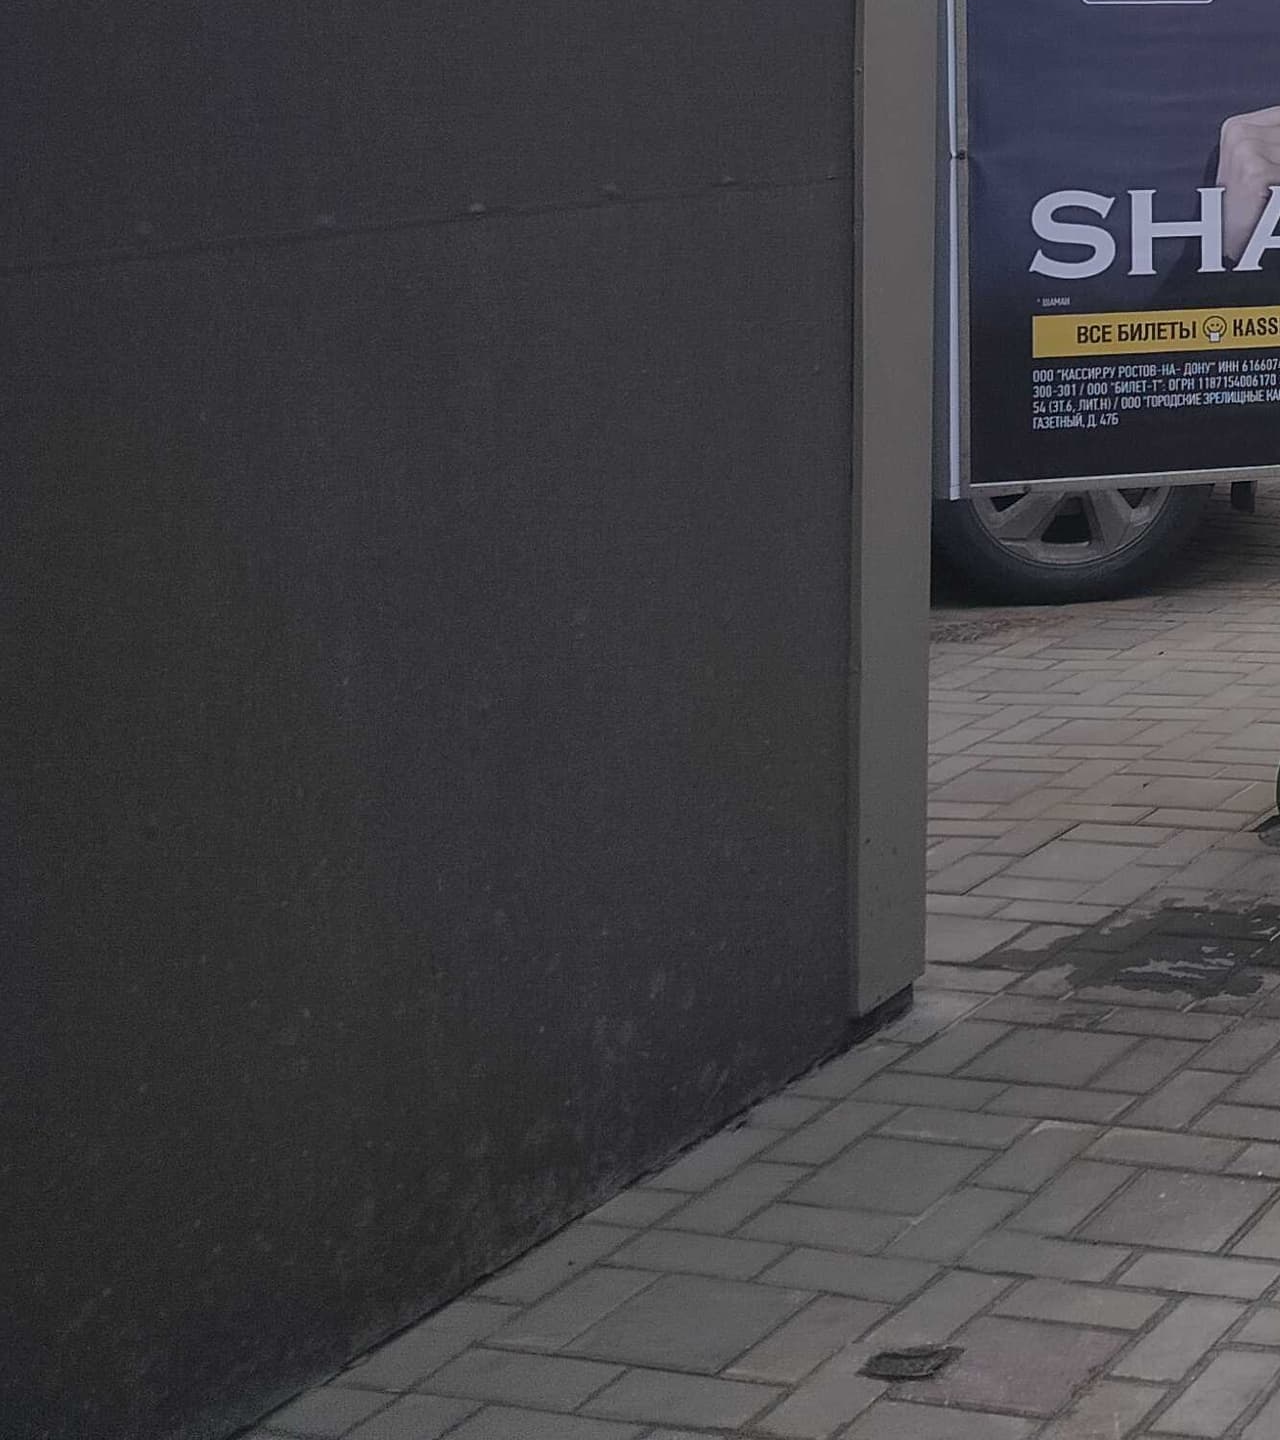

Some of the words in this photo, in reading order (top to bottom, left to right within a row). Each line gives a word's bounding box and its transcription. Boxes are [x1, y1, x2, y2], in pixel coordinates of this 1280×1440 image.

[1076, 325, 1112, 344] ВСЕ
[1117, 321, 1197, 342] БИЛЕТЫ
[1033, 369, 1054, 382] ООО
[1218, 360, 1239, 373] ИНН
[1033, 384, 1077, 398] 300-301
[1087, 382, 1108, 396] ООО
[1168, 377, 1195, 392] ОГРН
[1033, 401, 1046, 414] 54
[1121, 396, 1141, 410] ООО
[1203, 390, 1265, 405] ЗРЕЛИЩНЫЕ
